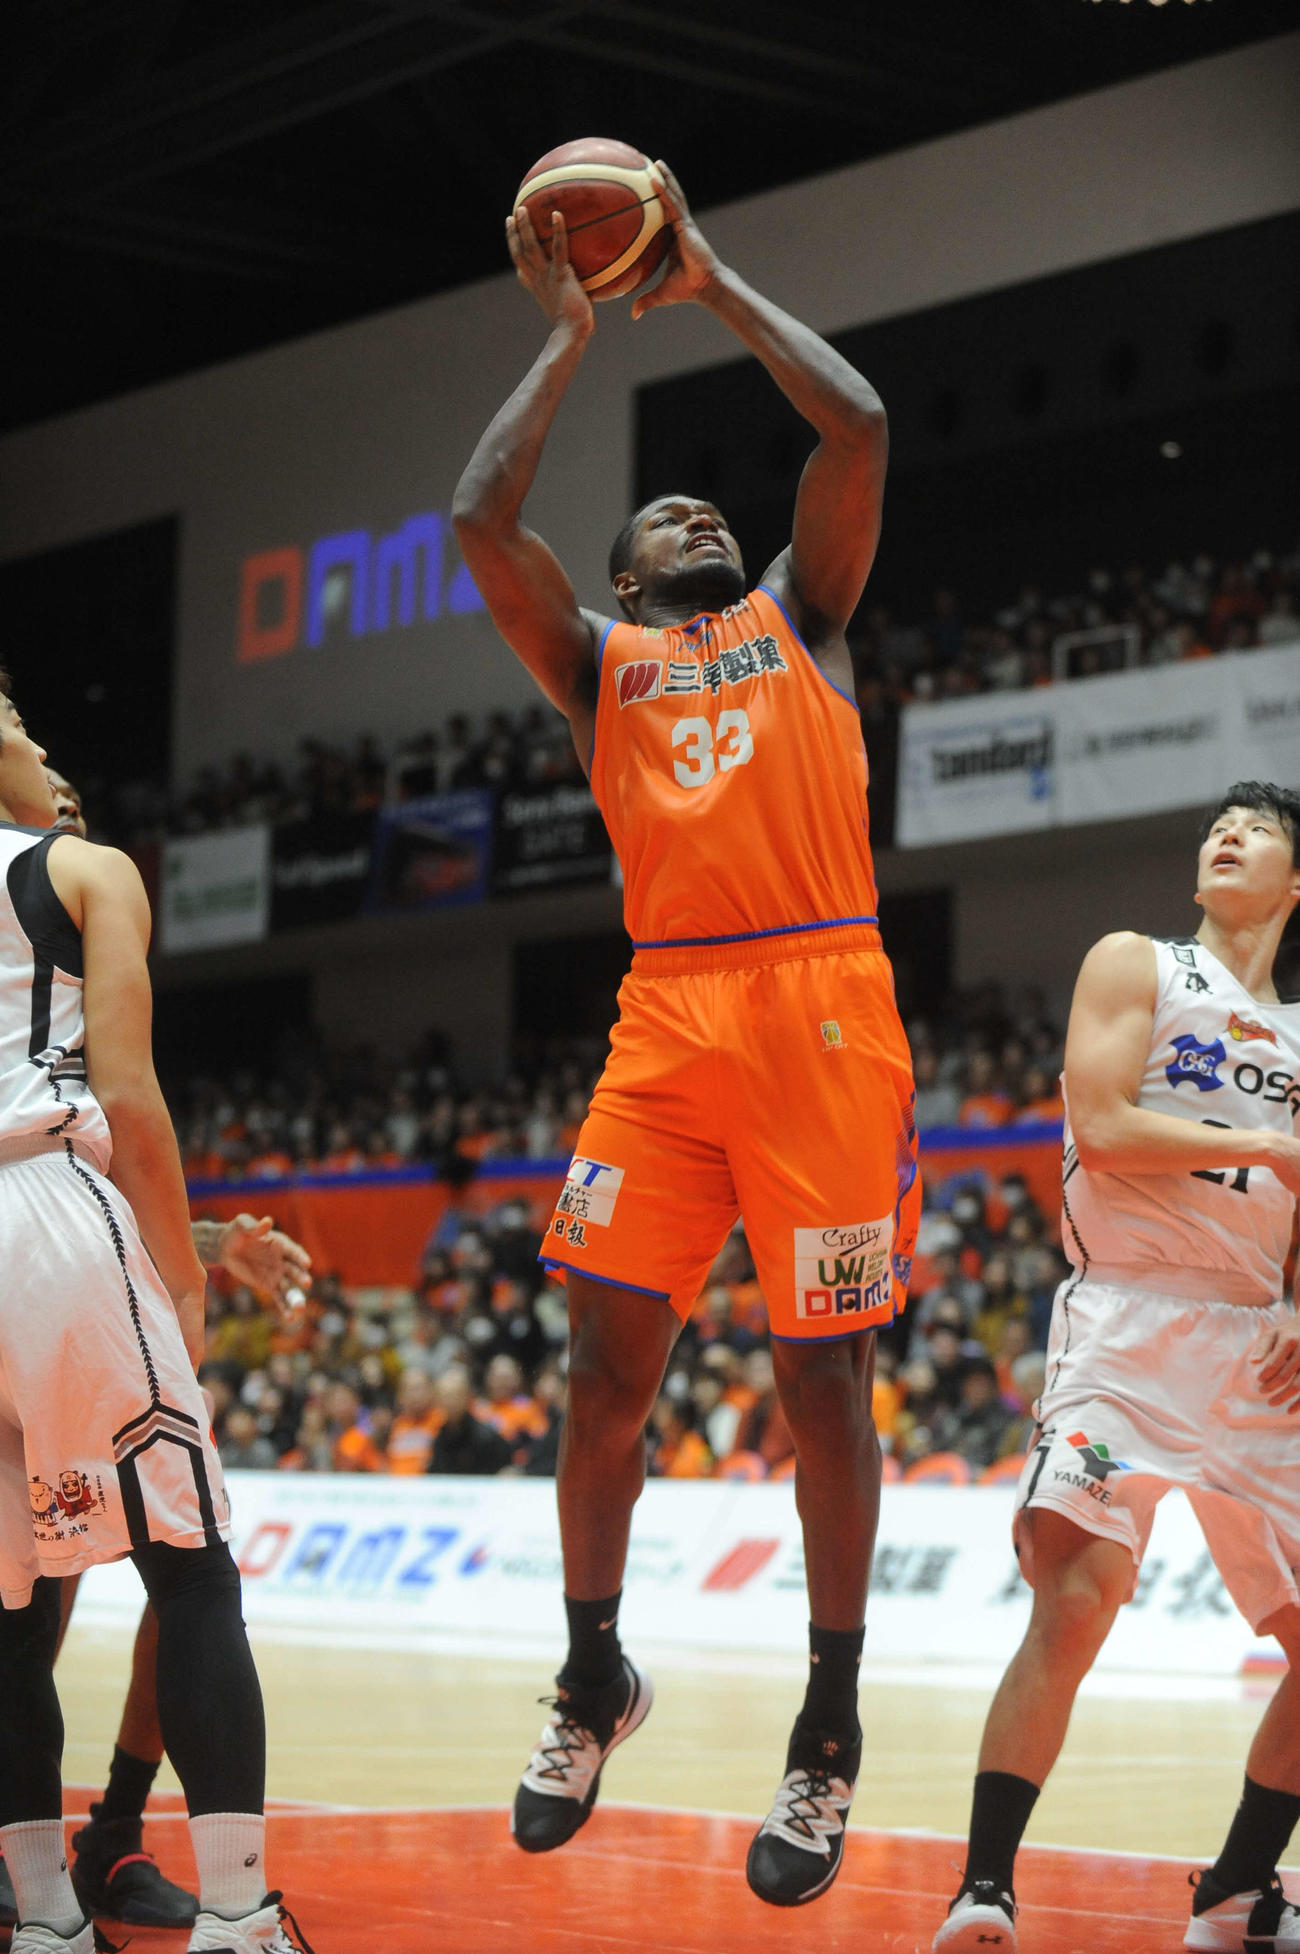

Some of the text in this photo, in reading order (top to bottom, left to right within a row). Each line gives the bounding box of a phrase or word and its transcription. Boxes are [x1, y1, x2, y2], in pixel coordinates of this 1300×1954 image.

[671, 708, 754, 788] 33
[821, 1225, 881, 1255] Crafty
[818, 1256, 865, 1286] UW
[1053, 1470, 1112, 1508] YAMAZE
